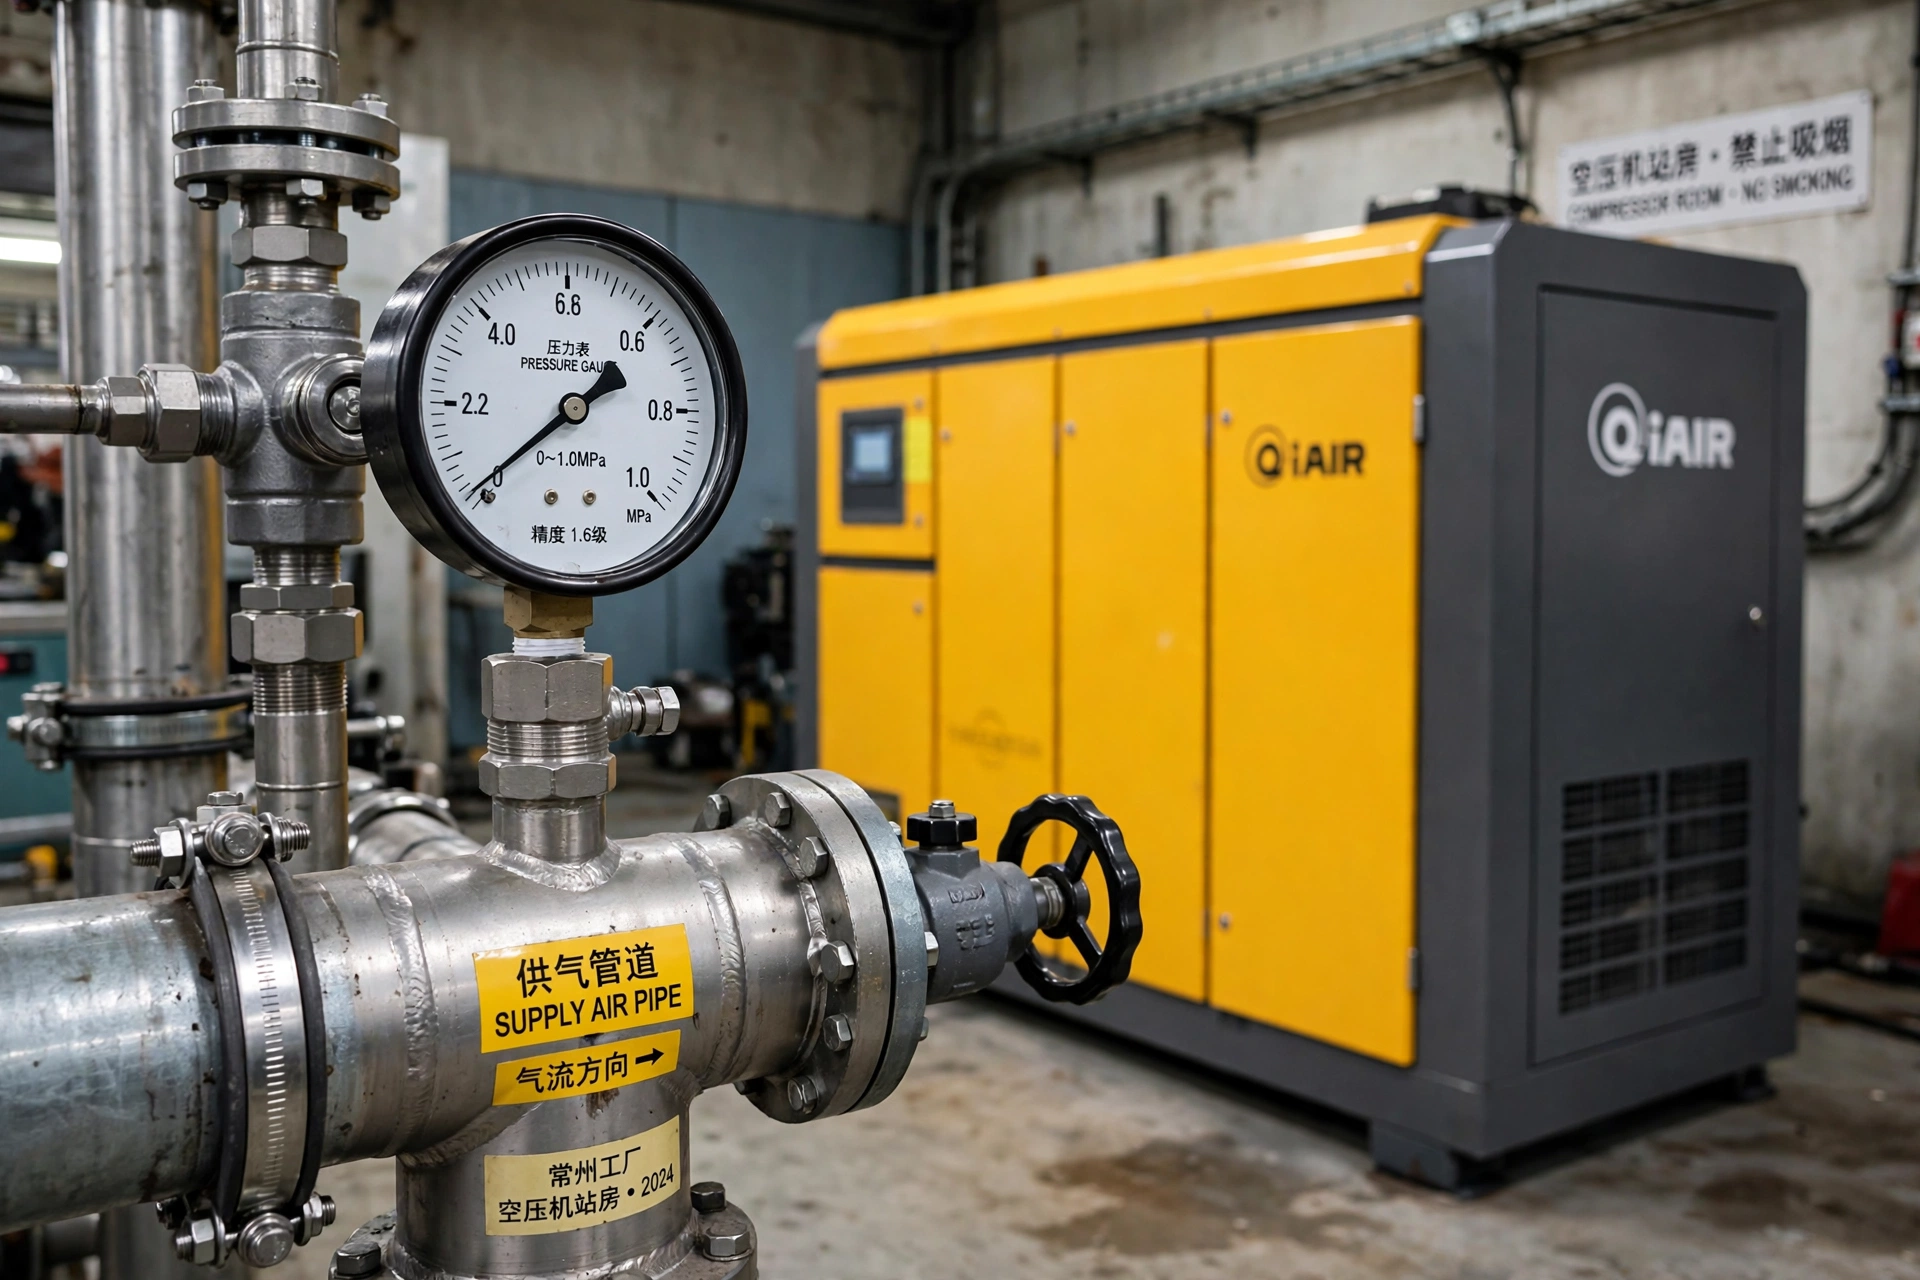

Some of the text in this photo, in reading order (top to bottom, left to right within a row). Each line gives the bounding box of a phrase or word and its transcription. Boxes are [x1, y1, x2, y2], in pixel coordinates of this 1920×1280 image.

[555, 292, 581, 316] 6.8
[487, 322, 516, 346] 4.0
[619, 329, 645, 353] 0.6
[546, 339, 590, 357] 压力表
[520, 356, 611, 374] PRESSURE GAU
[461, 392, 489, 416] 2.2
[647, 399, 673, 421] 0.8
[626, 466, 650, 488] 1.0
[626, 508, 652, 524] MPa
[531, 525, 608, 544] 精度 1.6级
[516, 942, 659, 998] 供气管道
[494, 983, 682, 1038] SUPPLY AIR PIPE
[516, 1051, 628, 1094] 气流方向
[549, 1146, 641, 1188] 常州工厂
